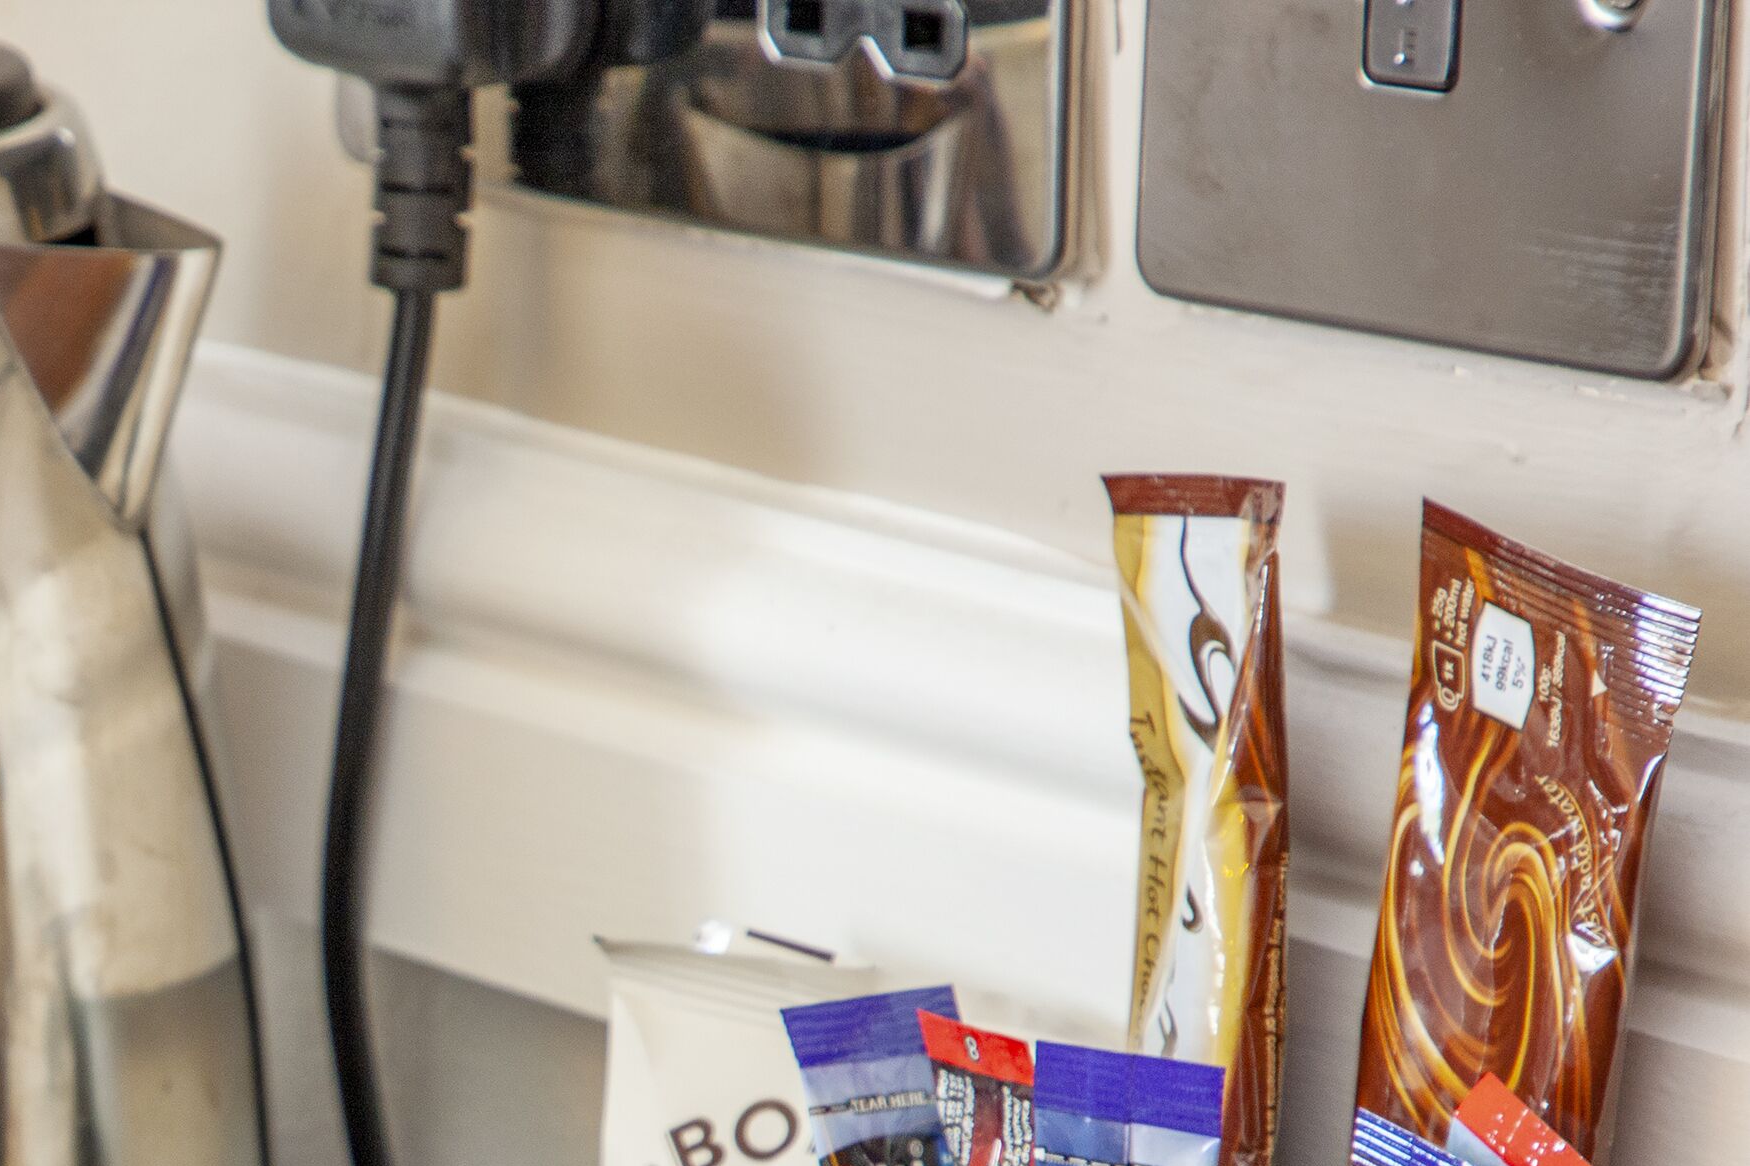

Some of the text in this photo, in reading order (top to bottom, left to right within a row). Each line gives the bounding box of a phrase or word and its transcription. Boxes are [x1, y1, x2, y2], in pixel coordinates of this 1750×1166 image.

[1454, 576, 1476, 648] hot water
[1482, 635, 1498, 682] 418kJ
[1495, 639, 1515, 692] 99kcal
[1146, 855, 1168, 922] Hot
[1570, 838, 1592, 890] add
